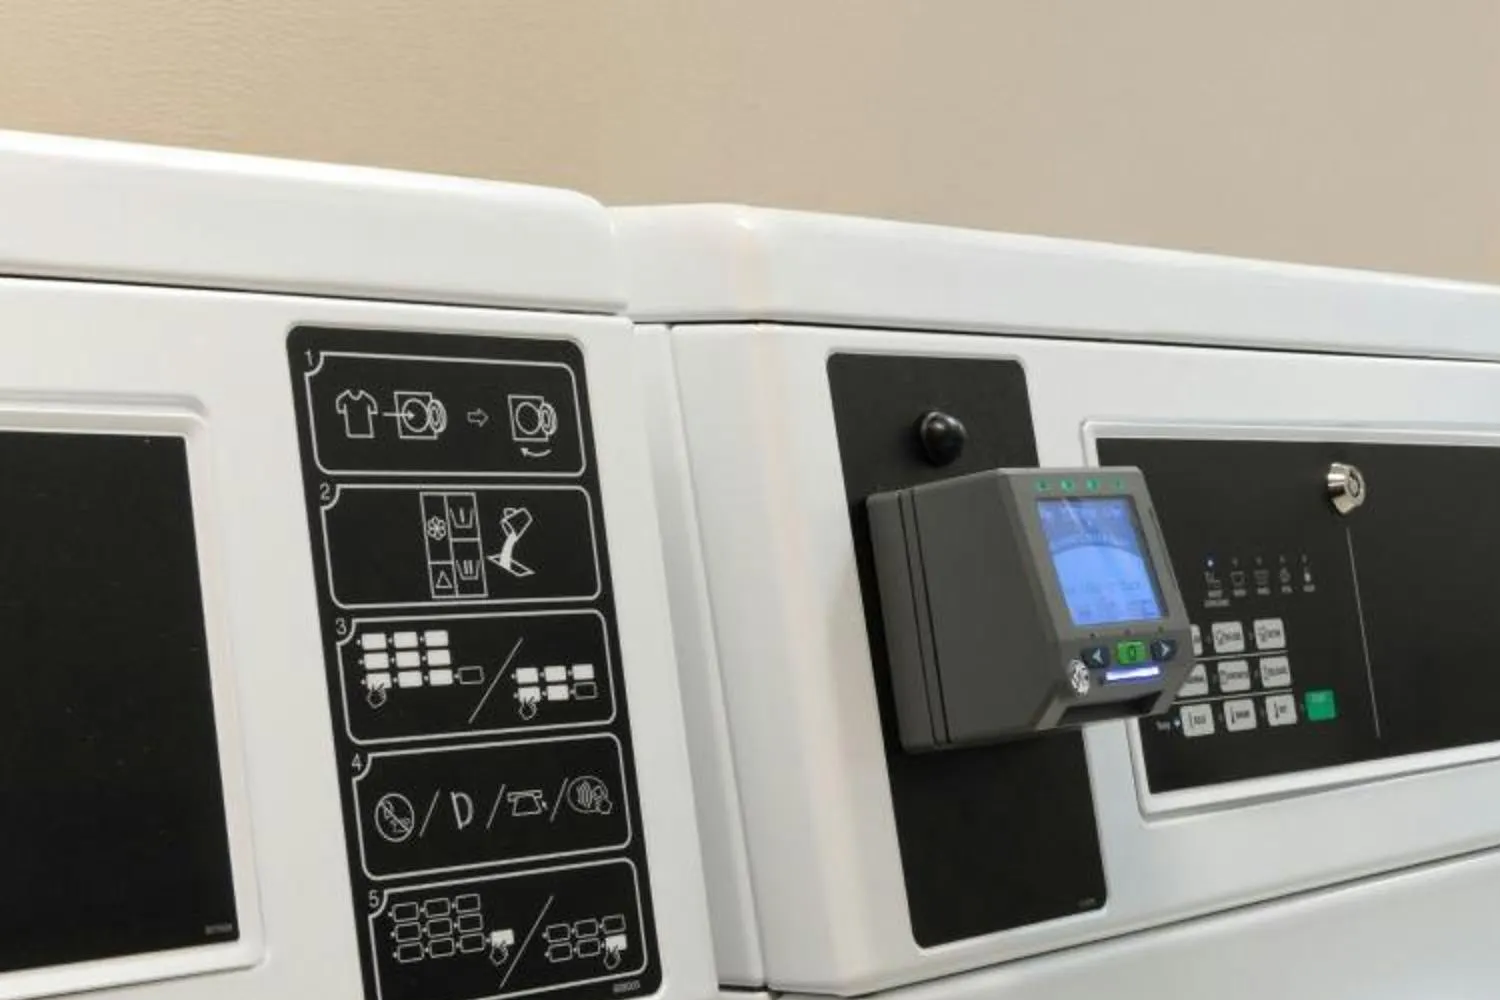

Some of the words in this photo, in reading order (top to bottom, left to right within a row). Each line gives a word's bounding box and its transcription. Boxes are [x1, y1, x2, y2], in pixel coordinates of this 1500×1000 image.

[320, 483, 331, 500] 2
[336, 617, 347, 634] 3
[351, 754, 362, 770] 4
[368, 890, 379, 907] 5
